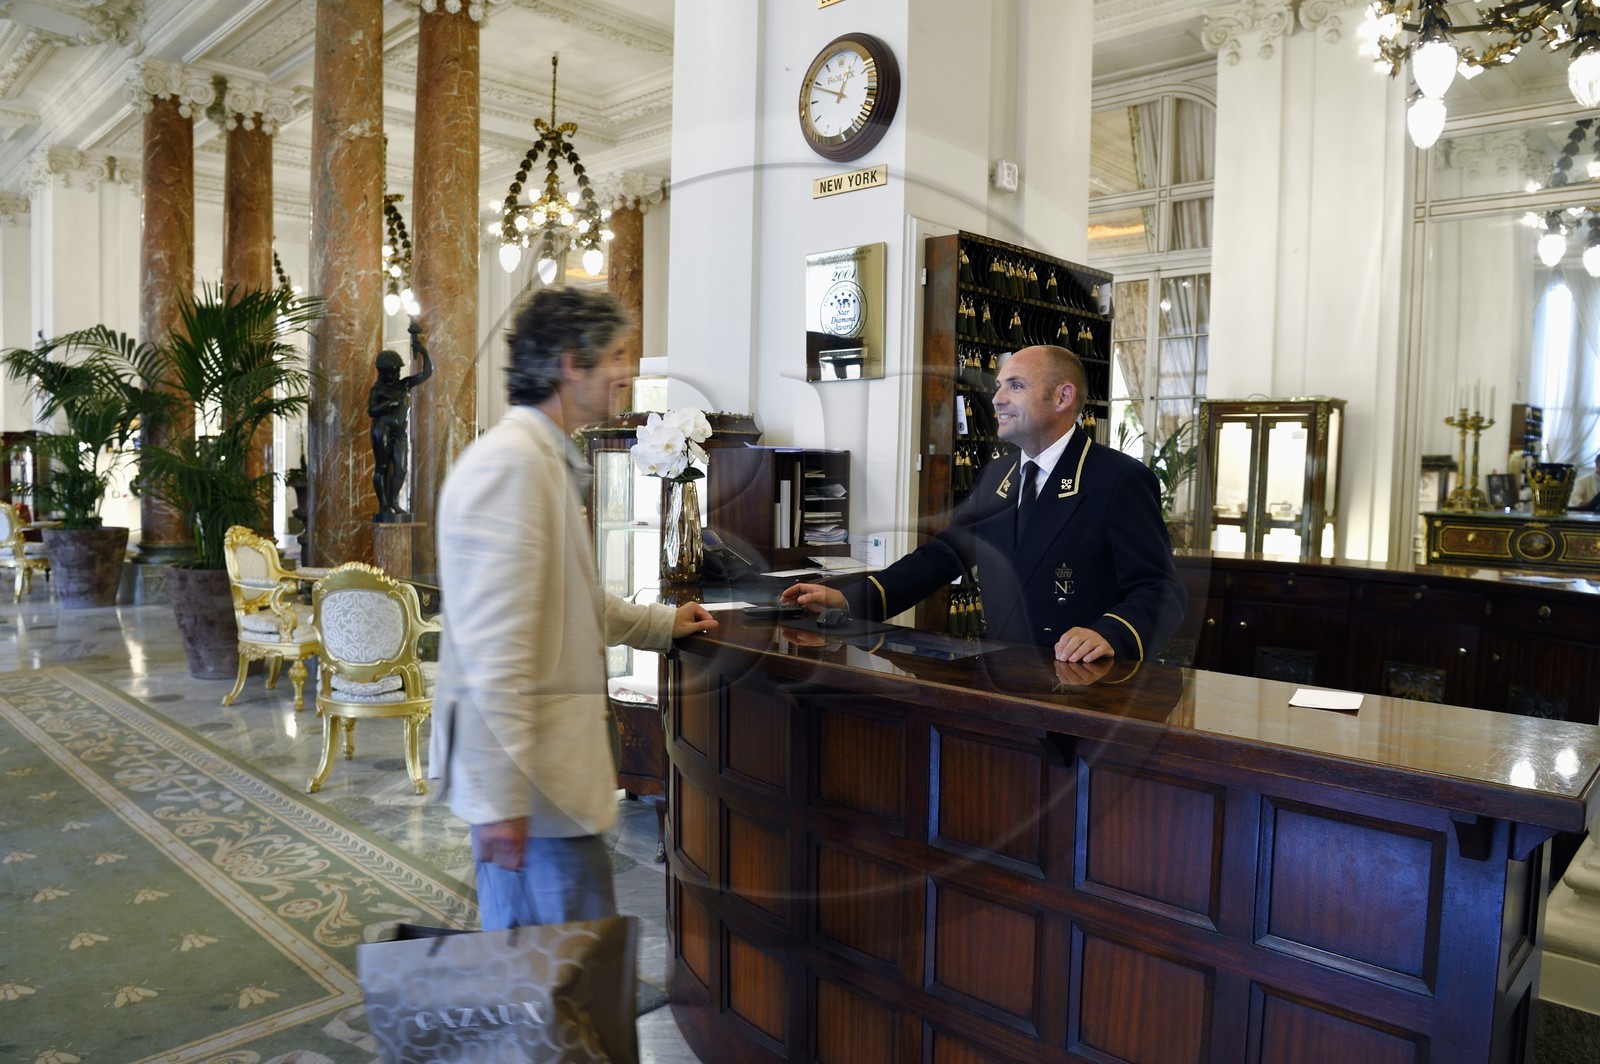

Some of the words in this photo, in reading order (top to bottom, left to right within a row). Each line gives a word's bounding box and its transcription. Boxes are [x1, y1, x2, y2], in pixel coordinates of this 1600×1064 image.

[820, 177, 843, 194] NEW
[848, 170, 878, 188] YORK
[831, 314, 857, 325] Diamond
